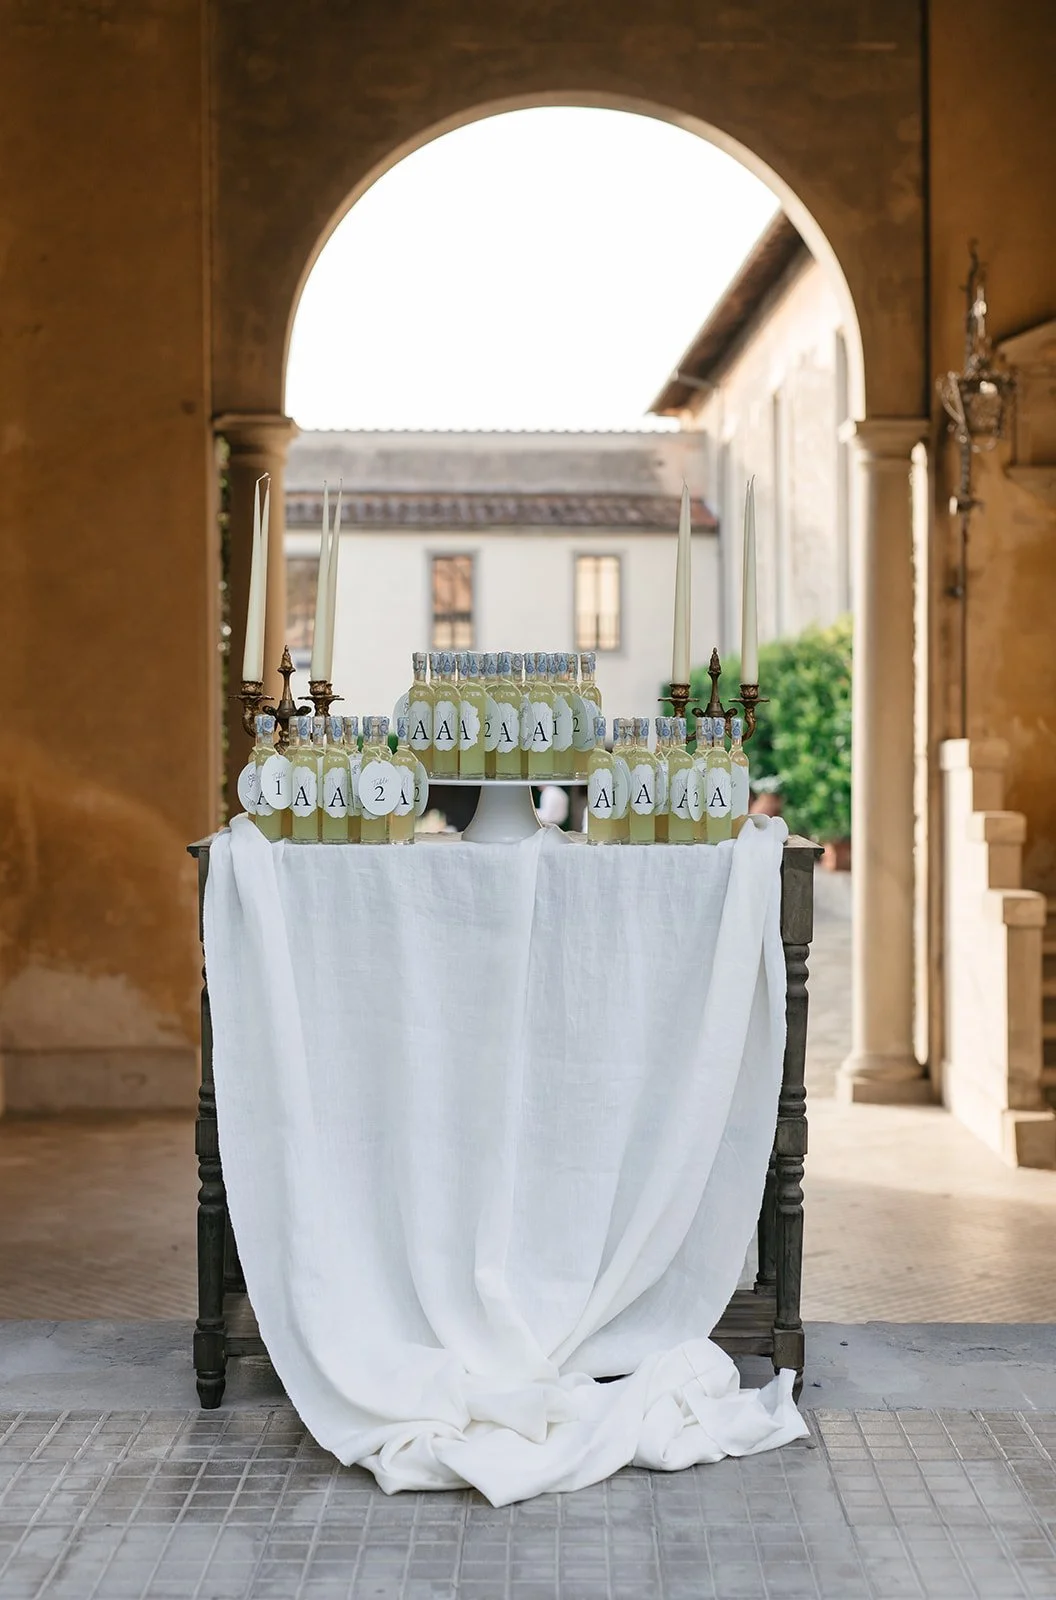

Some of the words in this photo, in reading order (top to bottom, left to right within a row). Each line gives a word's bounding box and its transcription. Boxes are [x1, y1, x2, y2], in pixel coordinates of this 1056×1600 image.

[411, 720, 429, 741] A
[436, 720, 454, 741] A
[498, 722, 513, 742] A
[532, 721, 548, 742] A
[275, 780, 282, 796] 1
[294, 785, 312, 807] A
[328, 787, 346, 807] A
[374, 785, 386, 802] 2
[593, 788, 611, 808] A
[634, 784, 653, 804] A
[709, 786, 727, 807] A
